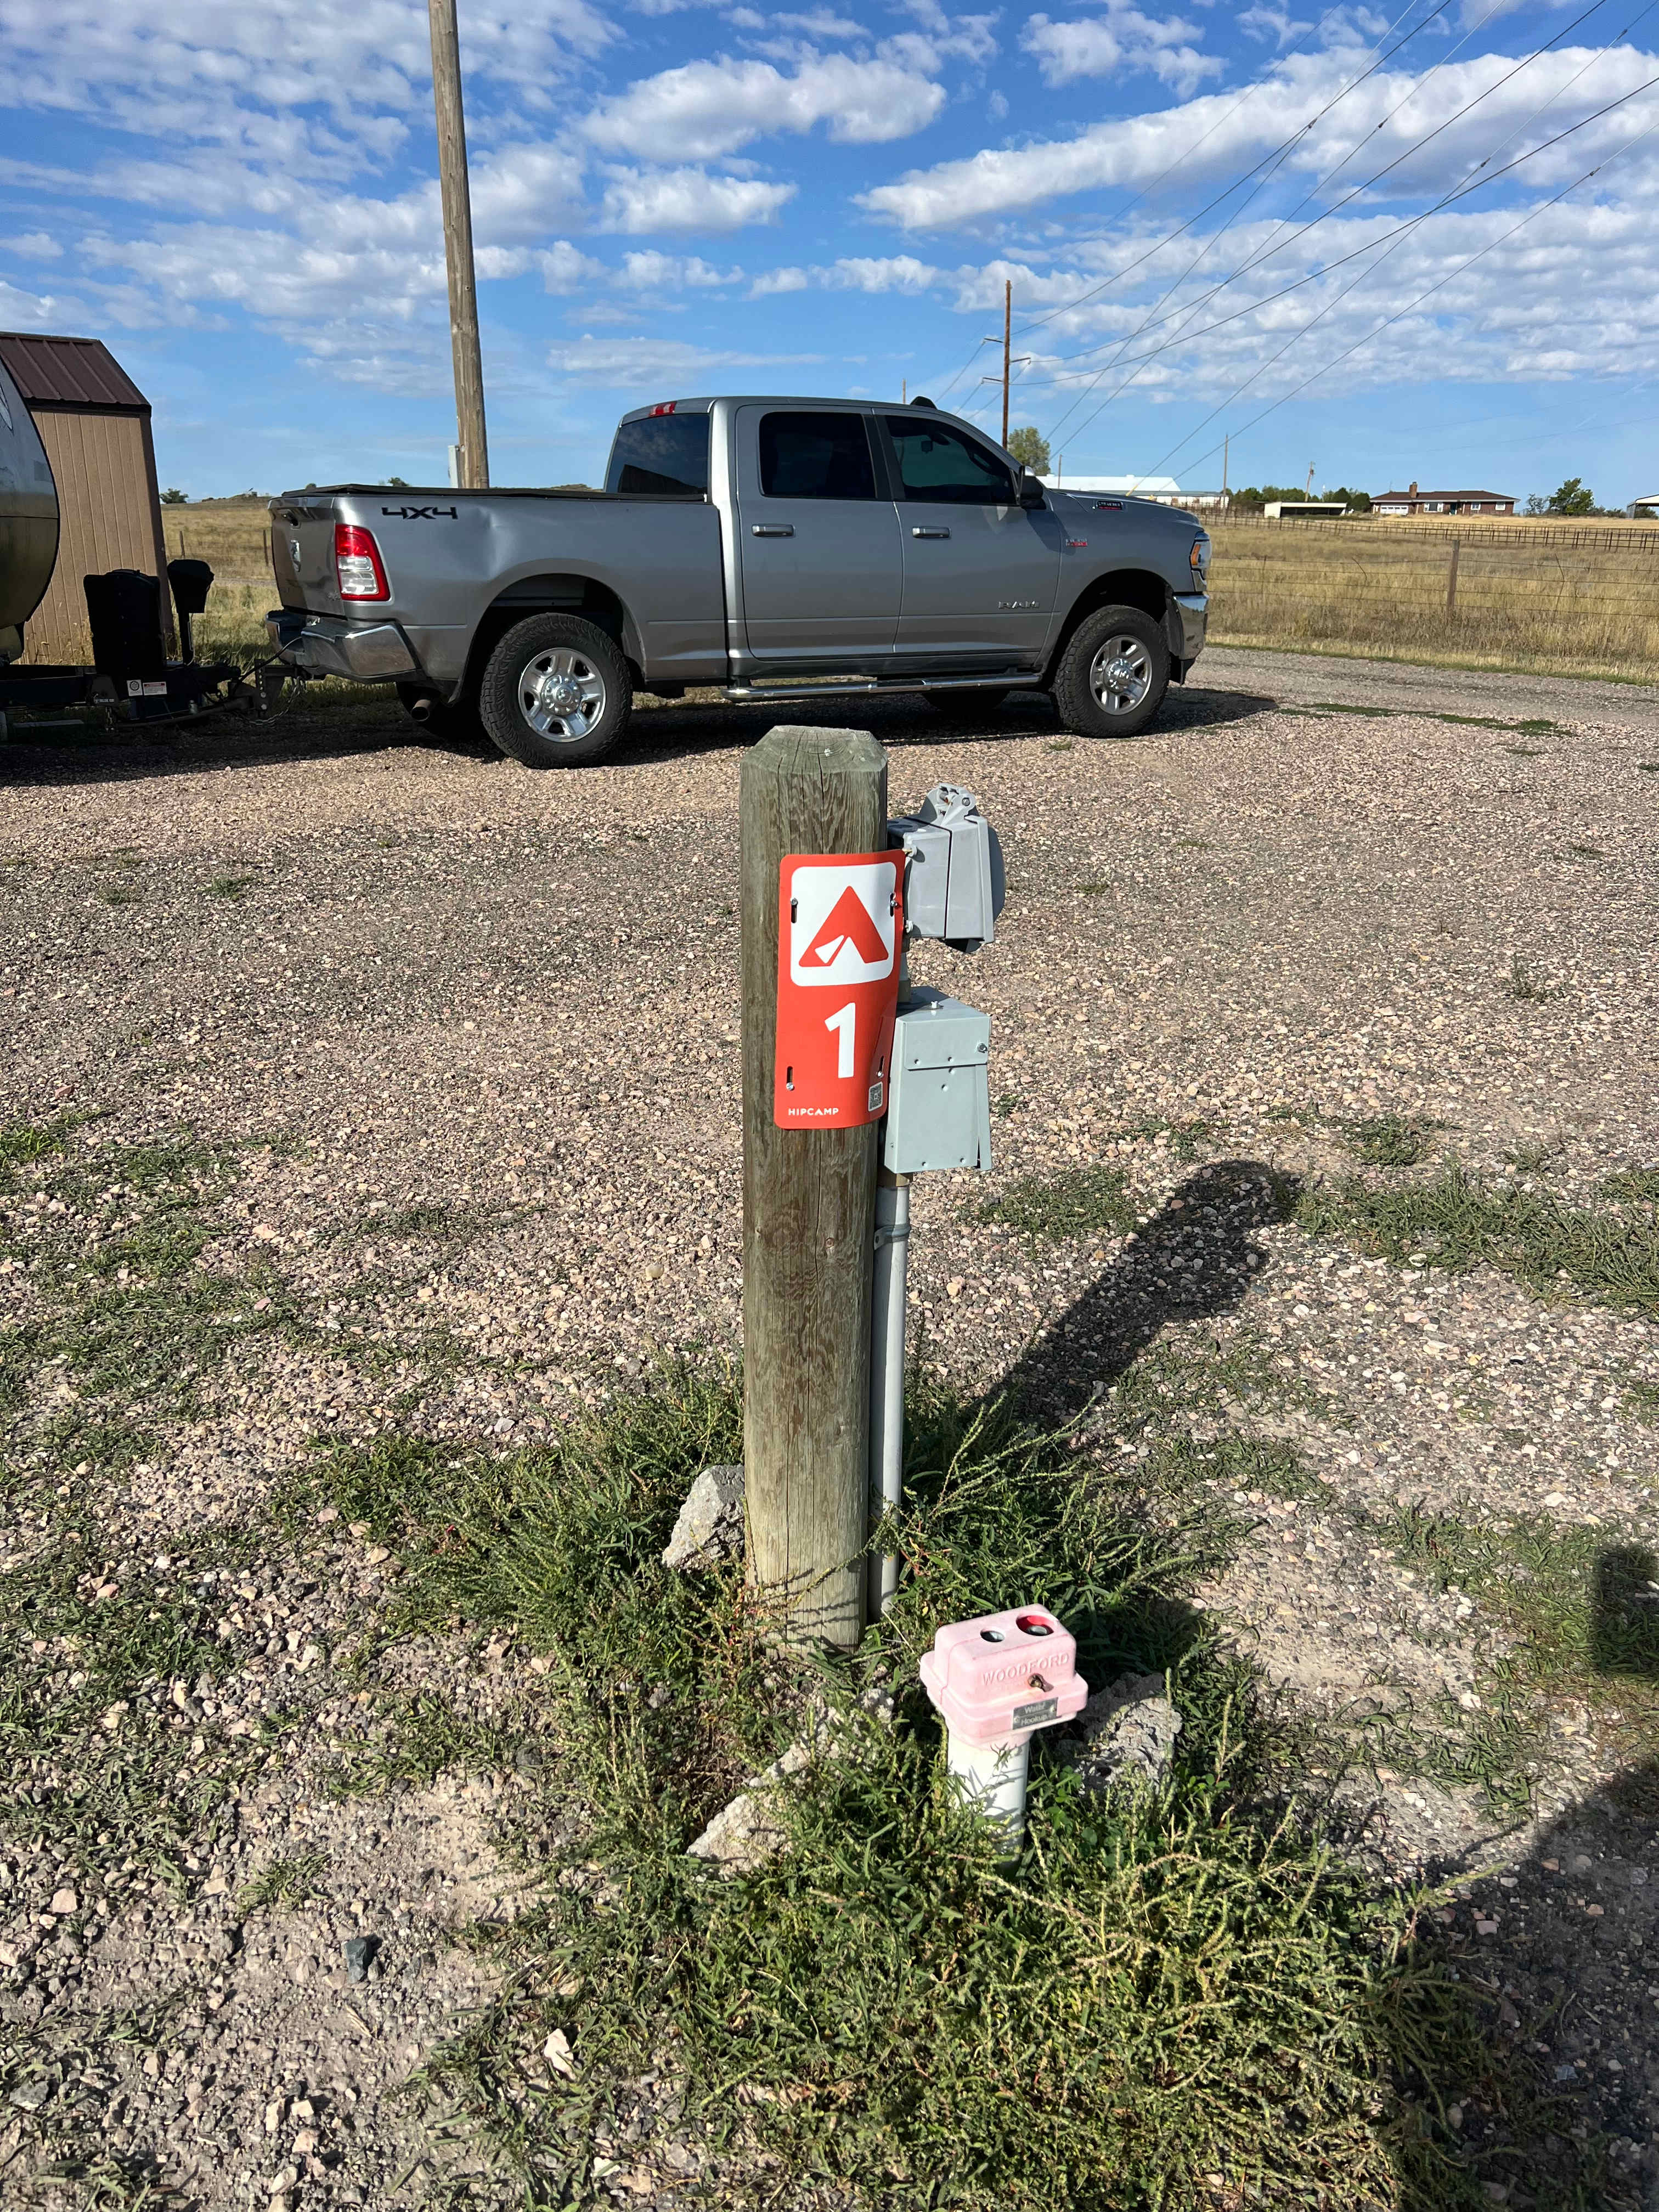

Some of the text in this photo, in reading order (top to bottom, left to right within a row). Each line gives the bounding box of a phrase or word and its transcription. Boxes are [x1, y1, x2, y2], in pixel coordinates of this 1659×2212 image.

[825, 1002, 856, 1079] 1
[788, 1107, 839, 1116] HIPCAMP
[983, 1652, 1069, 1686] WOODFORD
[1020, 1714, 1048, 1726] Hookup
